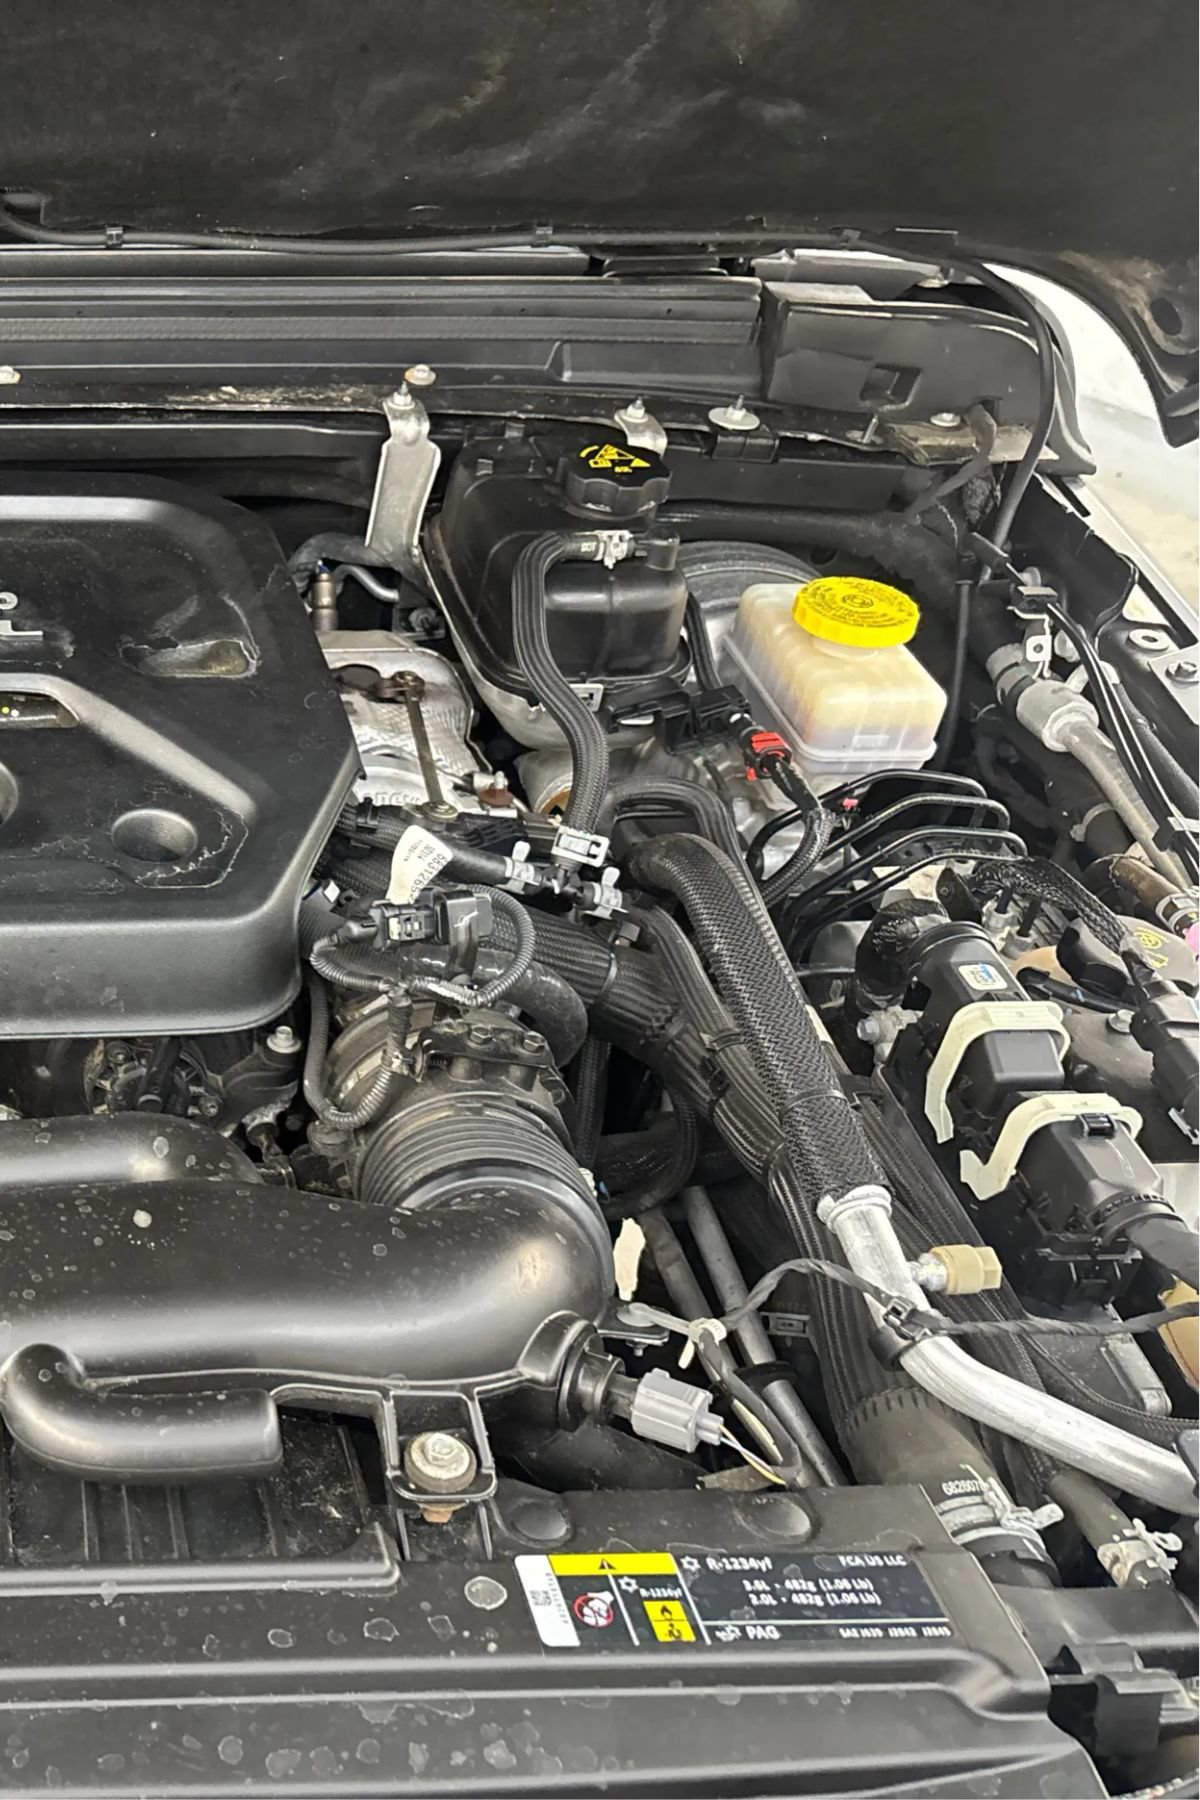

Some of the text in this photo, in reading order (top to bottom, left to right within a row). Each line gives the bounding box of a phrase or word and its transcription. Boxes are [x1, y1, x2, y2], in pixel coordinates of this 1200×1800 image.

[706, 1556, 774, 1573] R-1234yf
[838, 1555, 908, 1567] FCA US LLC
[746, 1625, 781, 1640] PAG
